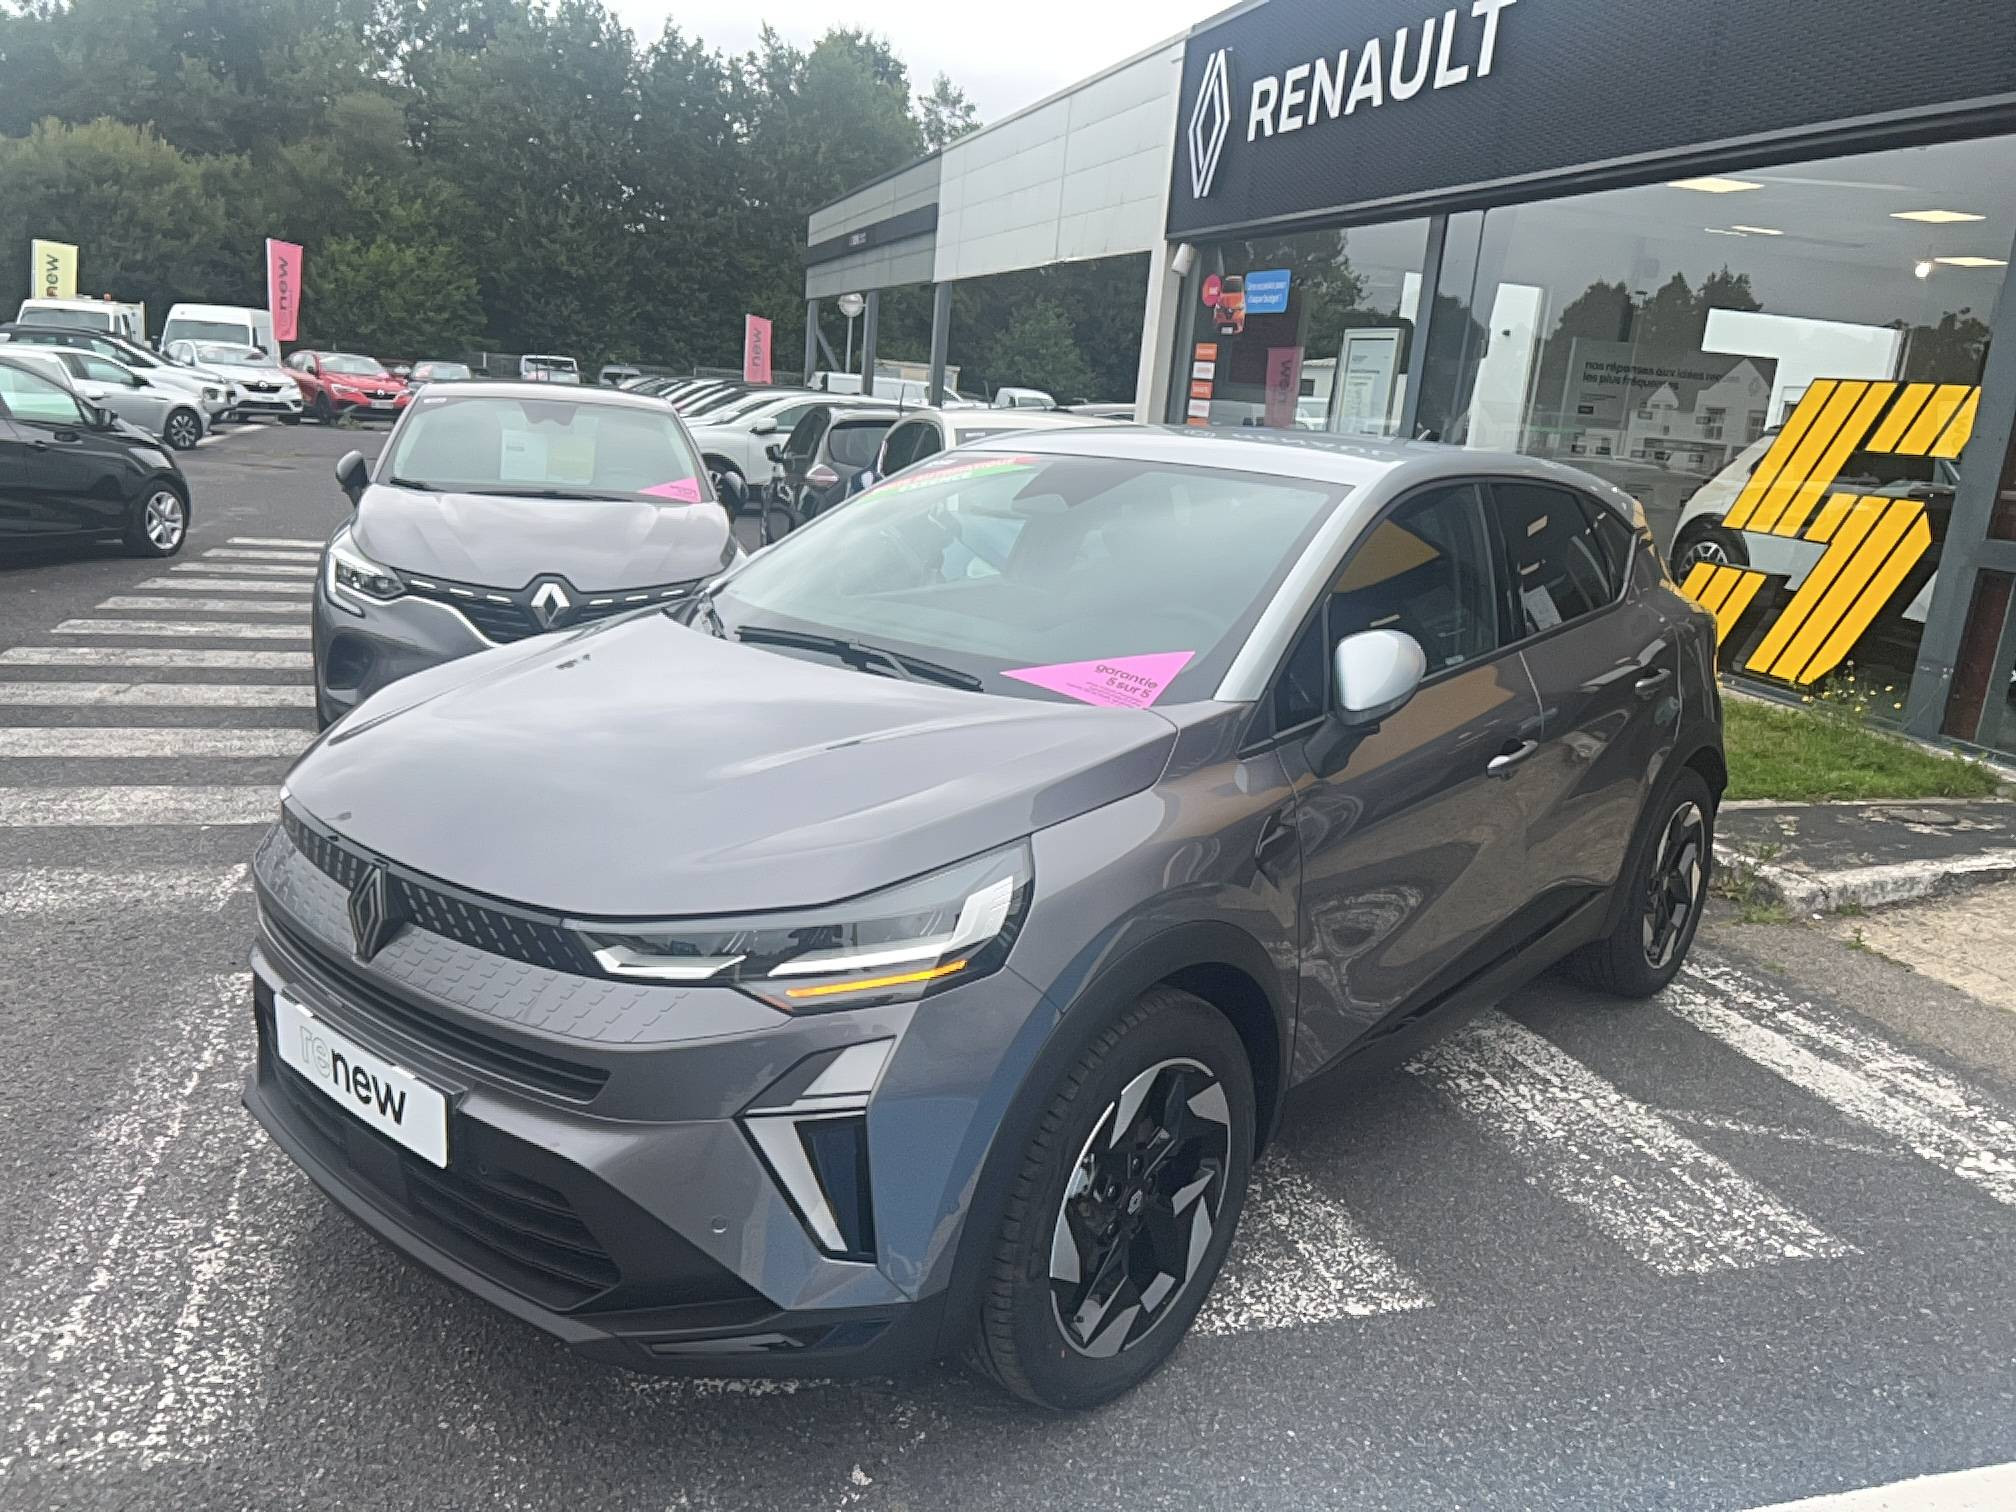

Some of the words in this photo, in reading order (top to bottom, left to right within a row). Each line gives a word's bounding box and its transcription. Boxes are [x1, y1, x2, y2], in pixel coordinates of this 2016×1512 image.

[1247, 0, 1518, 142] RENAULT
[1095, 664, 1158, 688] garantie
[1116, 681, 1141, 695] sur
[1140, 688, 1152, 699] 5
[299, 1025, 407, 1126] renew
